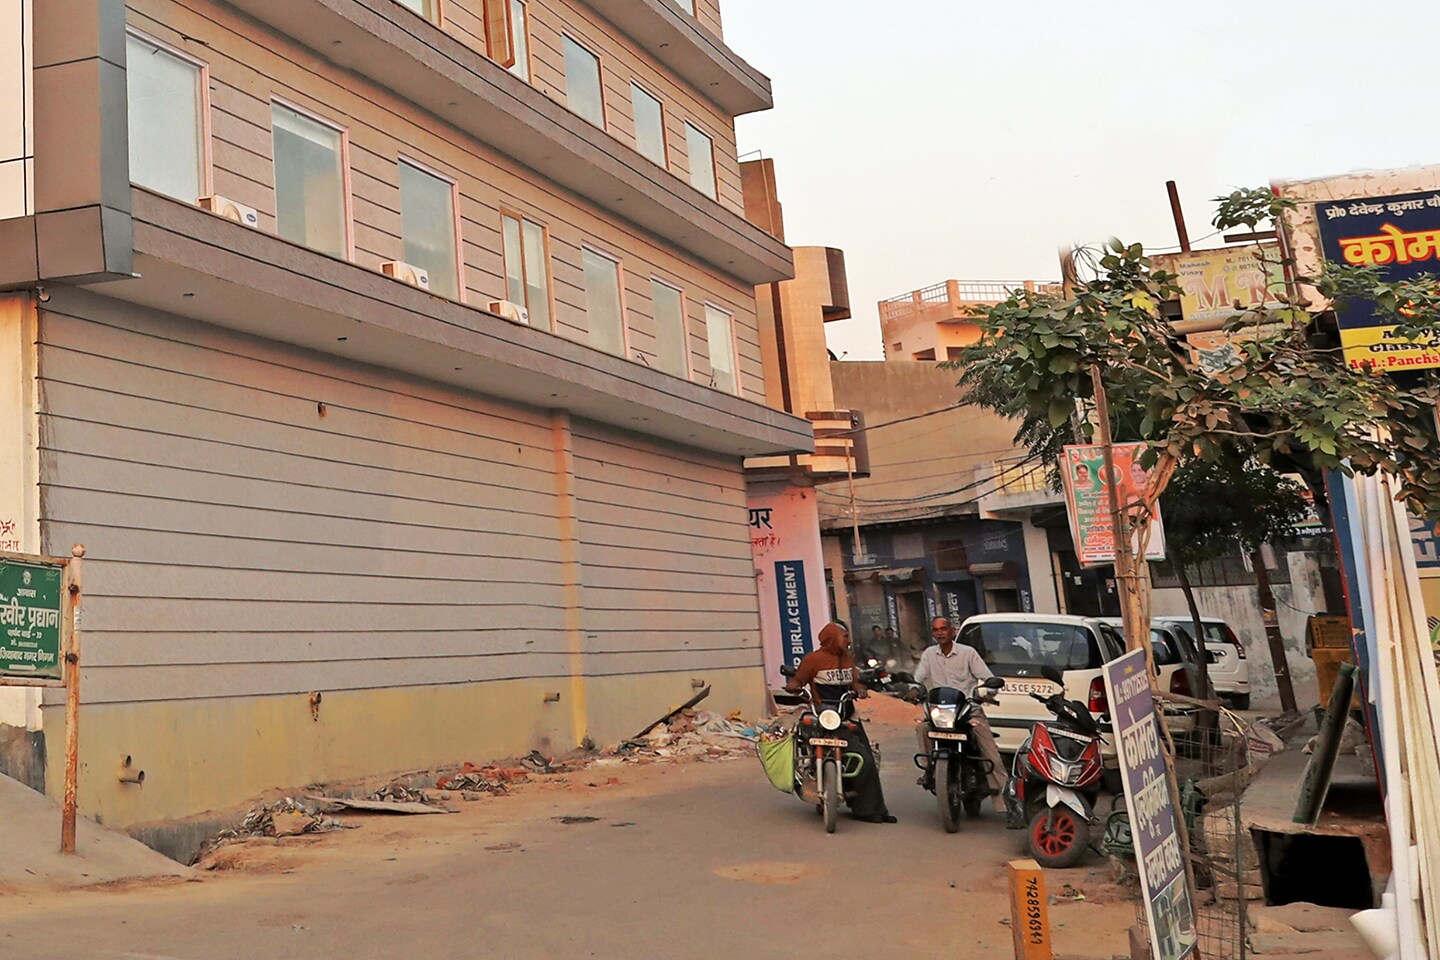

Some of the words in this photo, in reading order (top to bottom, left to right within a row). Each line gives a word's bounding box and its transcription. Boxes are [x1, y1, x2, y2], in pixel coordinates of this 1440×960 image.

[1348, 203, 1385, 218] देवेन्द्र
[1387, 199, 1425, 217] कुमार
[1179, 260, 1211, 270] Mahesh
[1180, 270, 1204, 278] Vinay
[1031, 684, 1053, 694] 5272
[1121, 708, 1159, 771] कोमल
